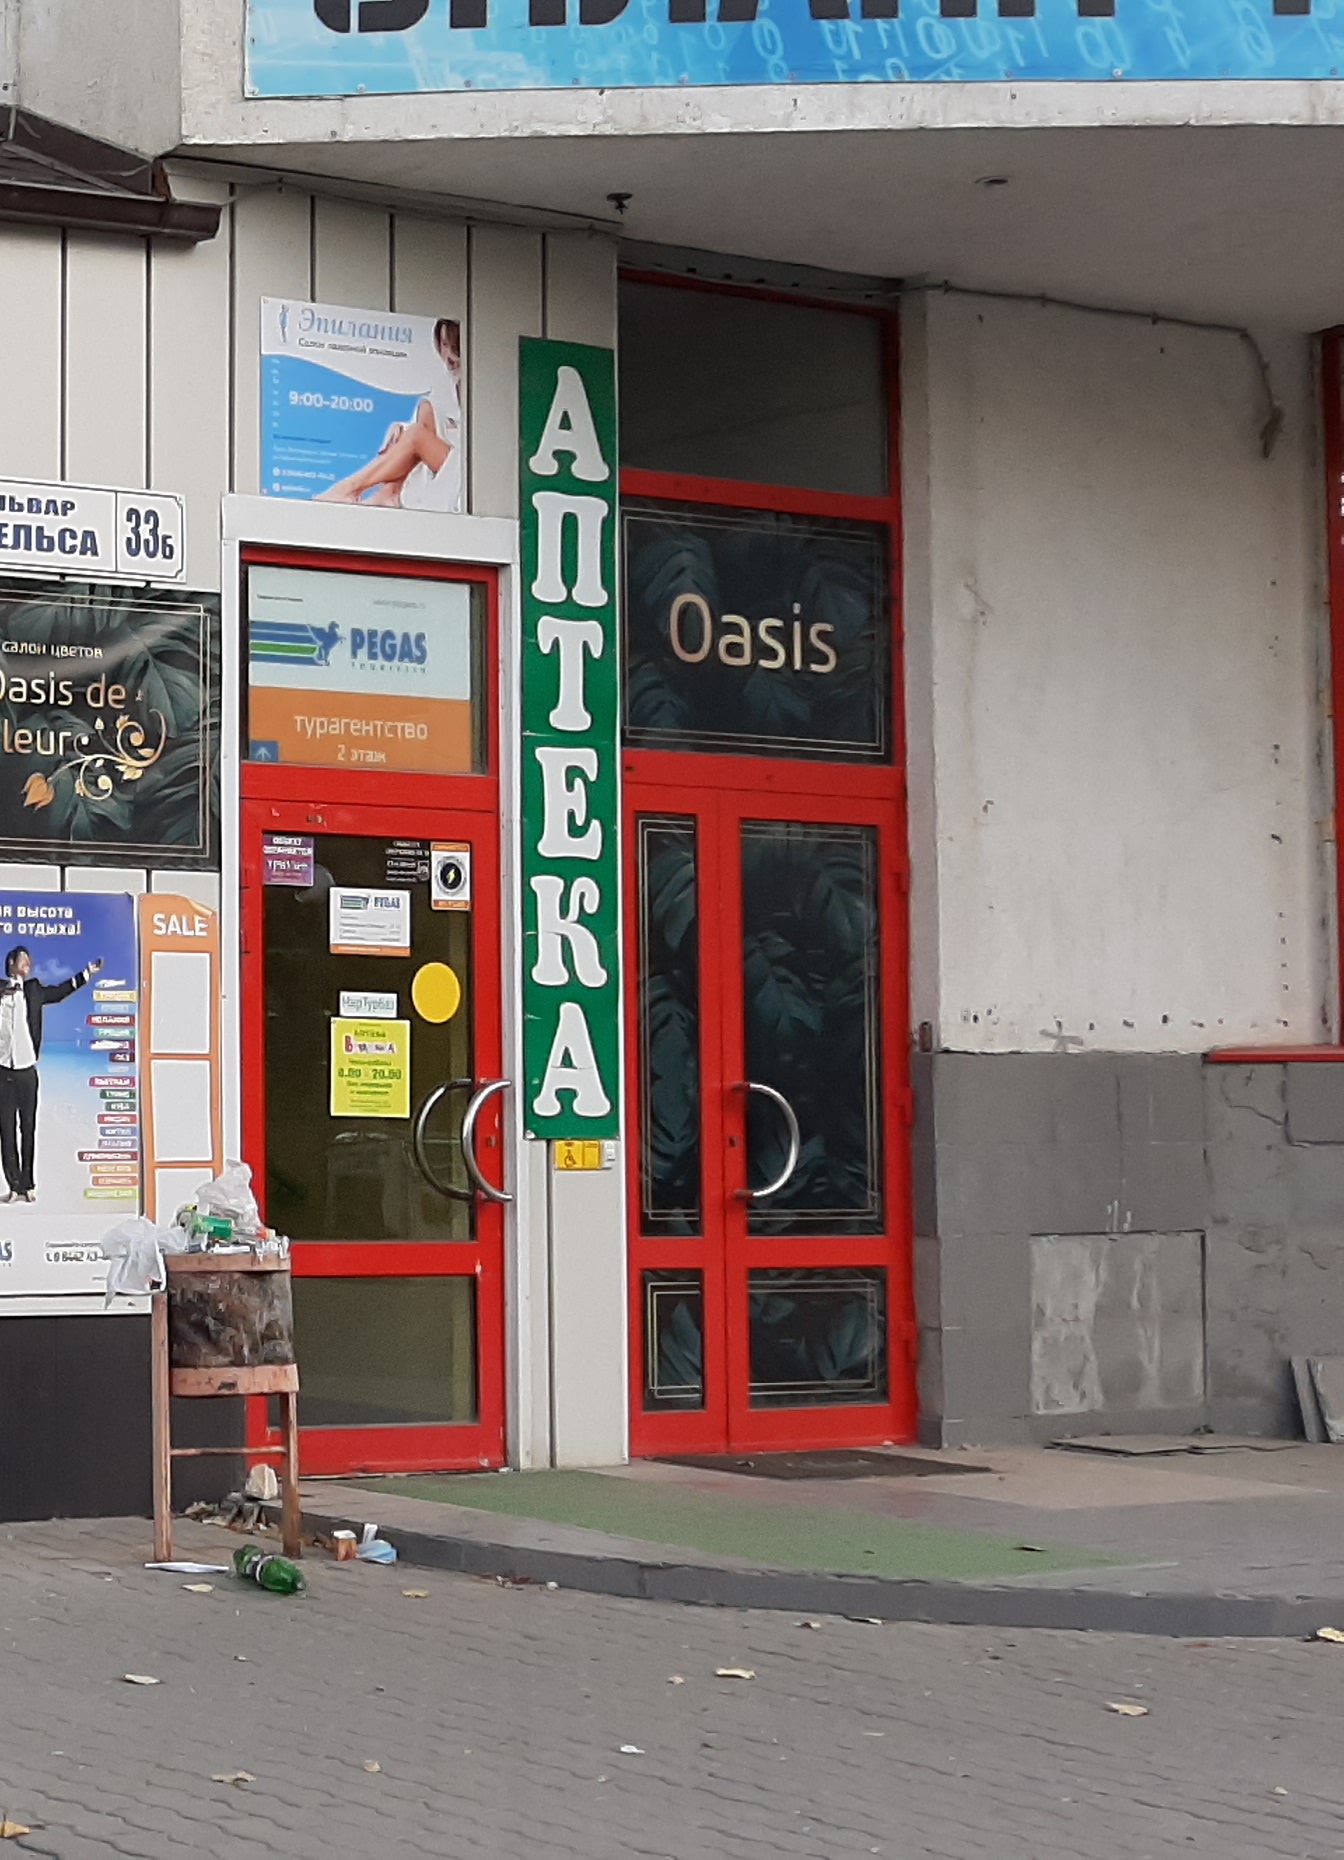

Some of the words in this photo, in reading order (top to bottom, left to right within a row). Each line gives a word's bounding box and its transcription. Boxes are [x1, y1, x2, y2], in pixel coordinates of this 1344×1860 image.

[298, 308, 413, 344] Эпилания
[288, 390, 374, 413] 9:00-20:00
[669, 592, 838, 674] Oasis
[1, 640, 47, 656] салон
[50, 645, 105, 660] цветов
[350, 627, 428, 666] PEGAS
[85, 672, 127, 709] de
[293, 714, 429, 741] турагентство
[337, 744, 345, 761] 2
[350, 747, 387, 764] этаж
[529, 365, 611, 1118] АПТЕКА
[16, 906, 74, 919] высота
[152, 913, 209, 937] SALE
[17, 919, 81, 938] отдыха!
